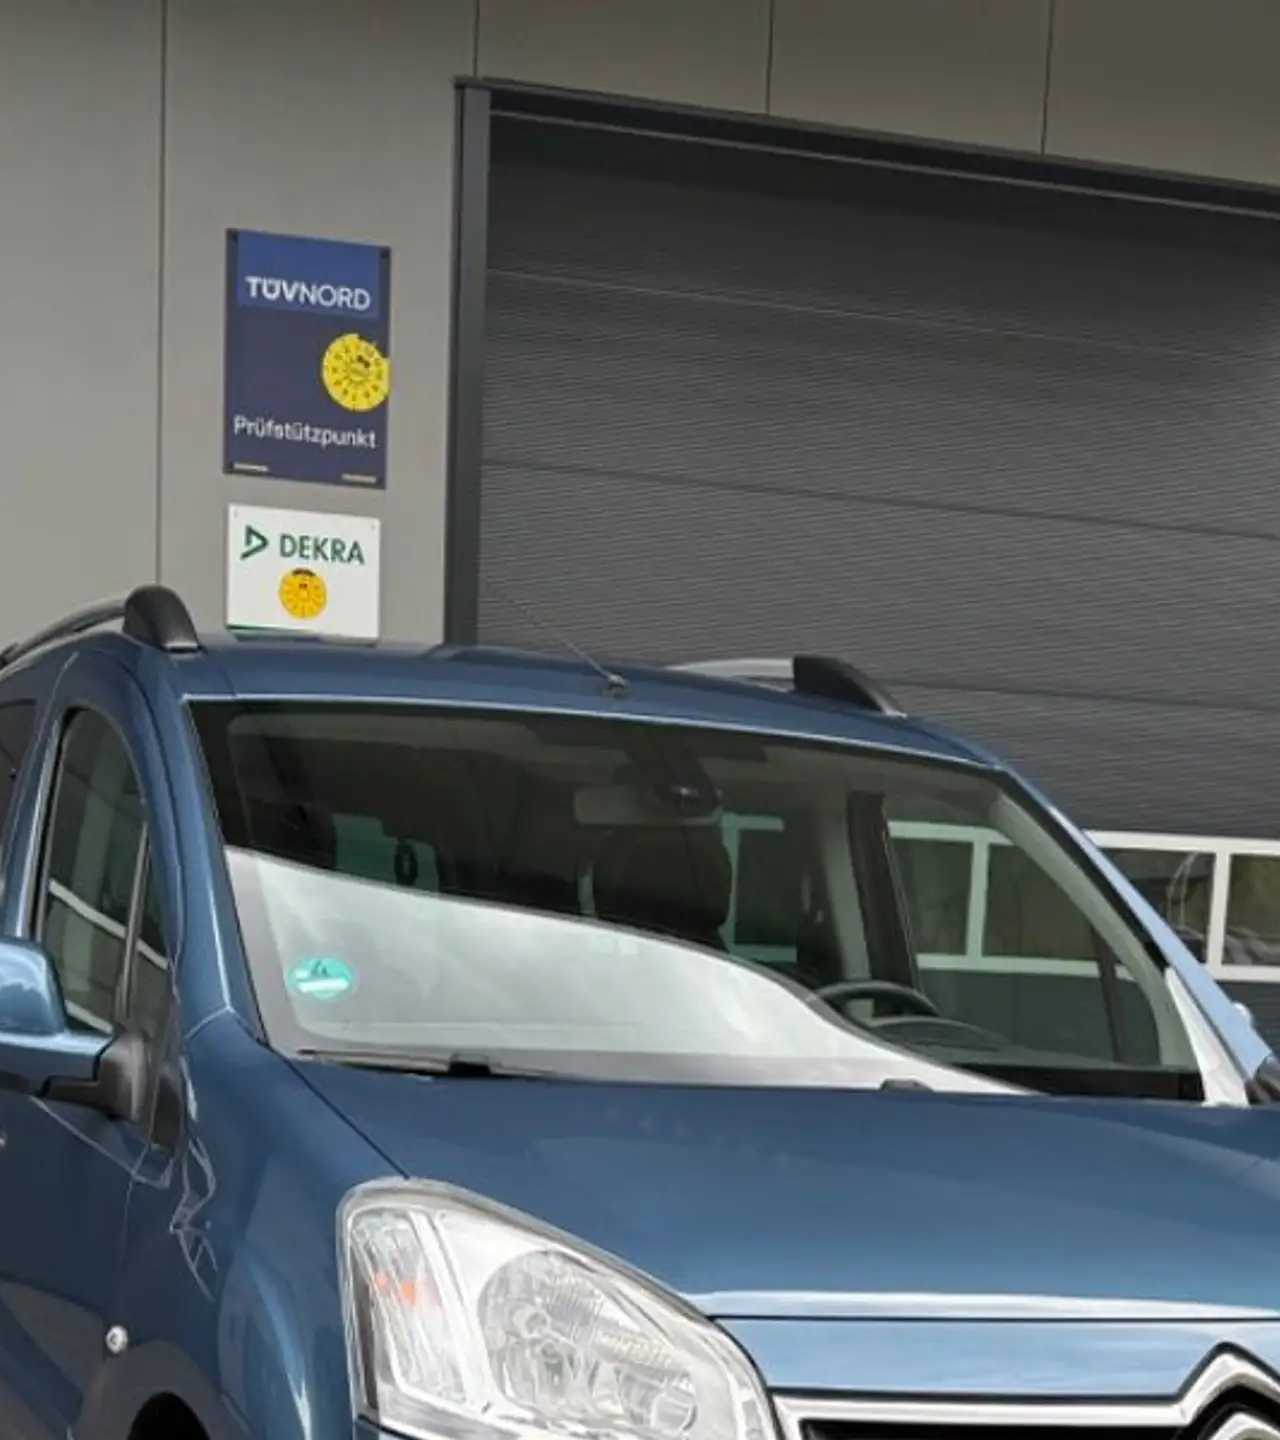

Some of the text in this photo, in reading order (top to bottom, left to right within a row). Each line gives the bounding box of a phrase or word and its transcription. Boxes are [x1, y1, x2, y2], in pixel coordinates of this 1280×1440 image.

[245, 275, 371, 311] TÜVNORD
[233, 415, 376, 449] Prüfstützpunkt
[279, 533, 365, 565] DEKRA
